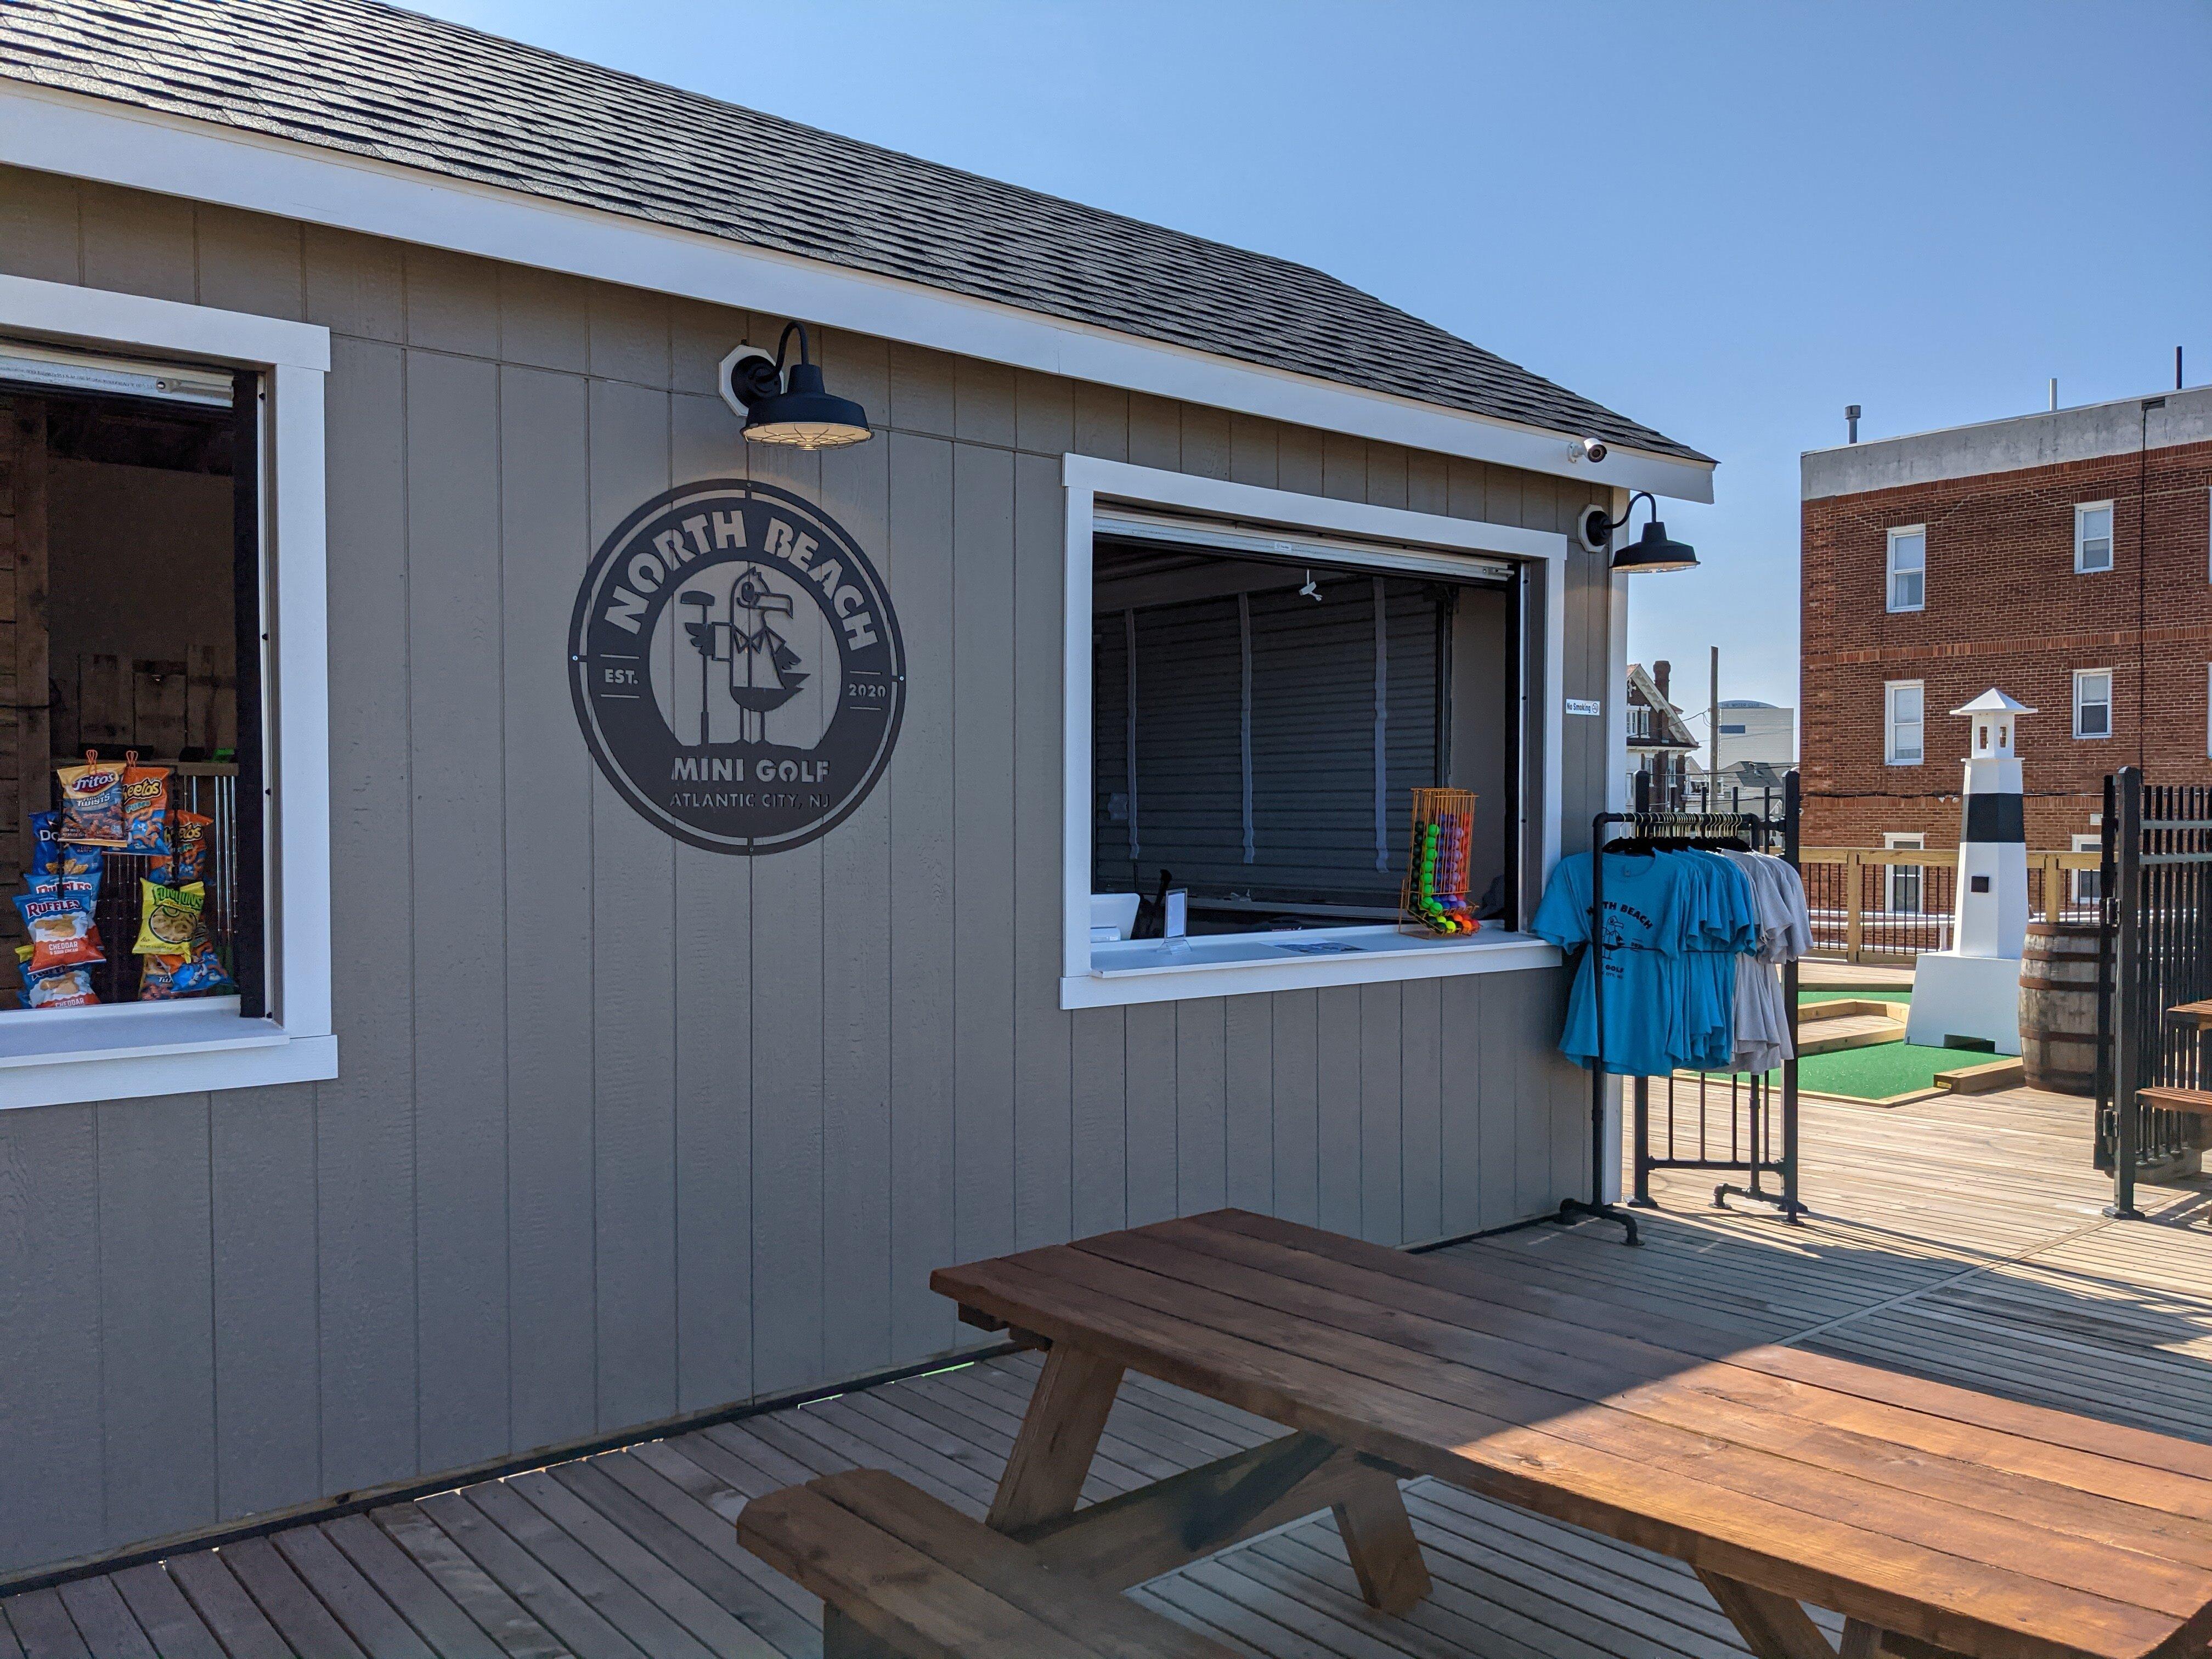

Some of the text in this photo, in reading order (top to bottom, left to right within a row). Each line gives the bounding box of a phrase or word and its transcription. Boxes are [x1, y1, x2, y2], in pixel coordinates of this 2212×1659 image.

[604, 510, 878, 651] NORTH BEACH
[605, 668, 639, 685] EST.
[849, 683, 887, 698] 2020
[1567, 702, 1591, 713] No Smoking
[671, 757, 830, 782] MINI GOLF
[669, 792, 830, 810] ATLANTIC CITY, NJ
[153, 885, 204, 909] FUNYUNS
[27, 900, 81, 918] RUFFLES
[1620, 904, 1654, 930] BEACH
[49, 941, 78, 950] CHEDDAR
[1605, 964, 1624, 973] GOLF
[55, 997, 84, 1007] CHEDDAR
